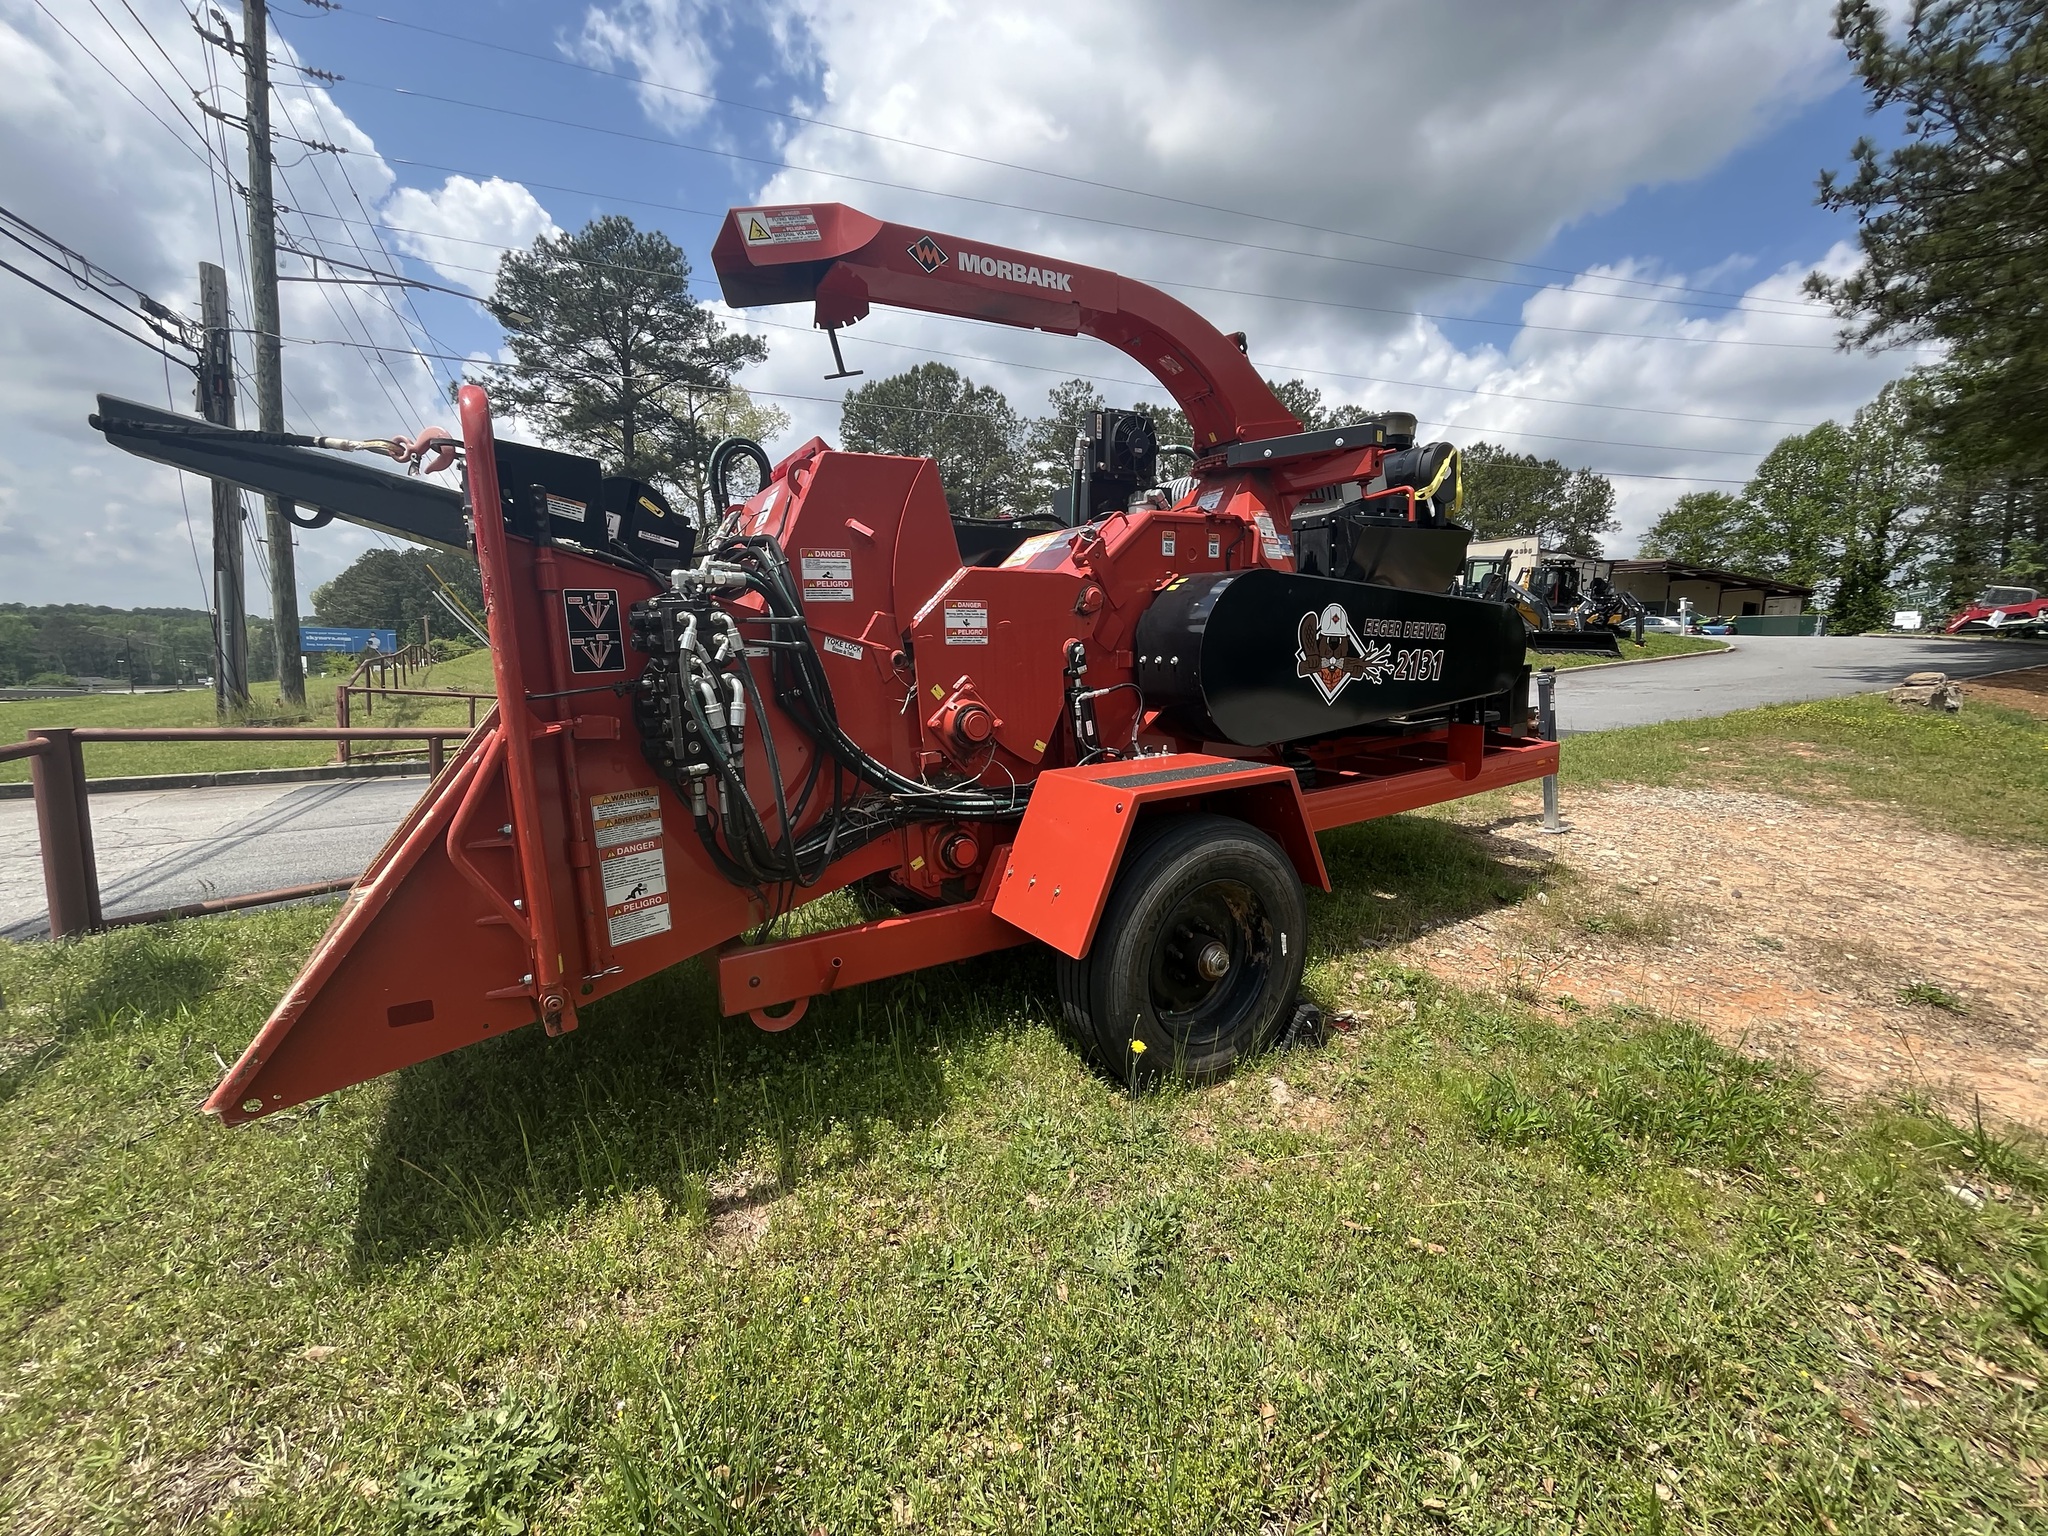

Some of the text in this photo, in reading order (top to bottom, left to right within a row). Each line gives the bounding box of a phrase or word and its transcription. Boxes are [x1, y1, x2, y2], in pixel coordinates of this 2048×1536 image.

[958, 251, 1072, 292] MORBARK
[1364, 618, 1446, 640] EEGER BEEVER
[827, 637, 843, 647] YOKE
[845, 642, 862, 652] LOCK
[1393, 649, 1444, 681] 2131
[611, 790, 649, 801] WARNING
[614, 813, 652, 825] ADVERTENCIA
[617, 841, 655, 855] DANGER
[623, 896, 662, 912] PELIGRO
